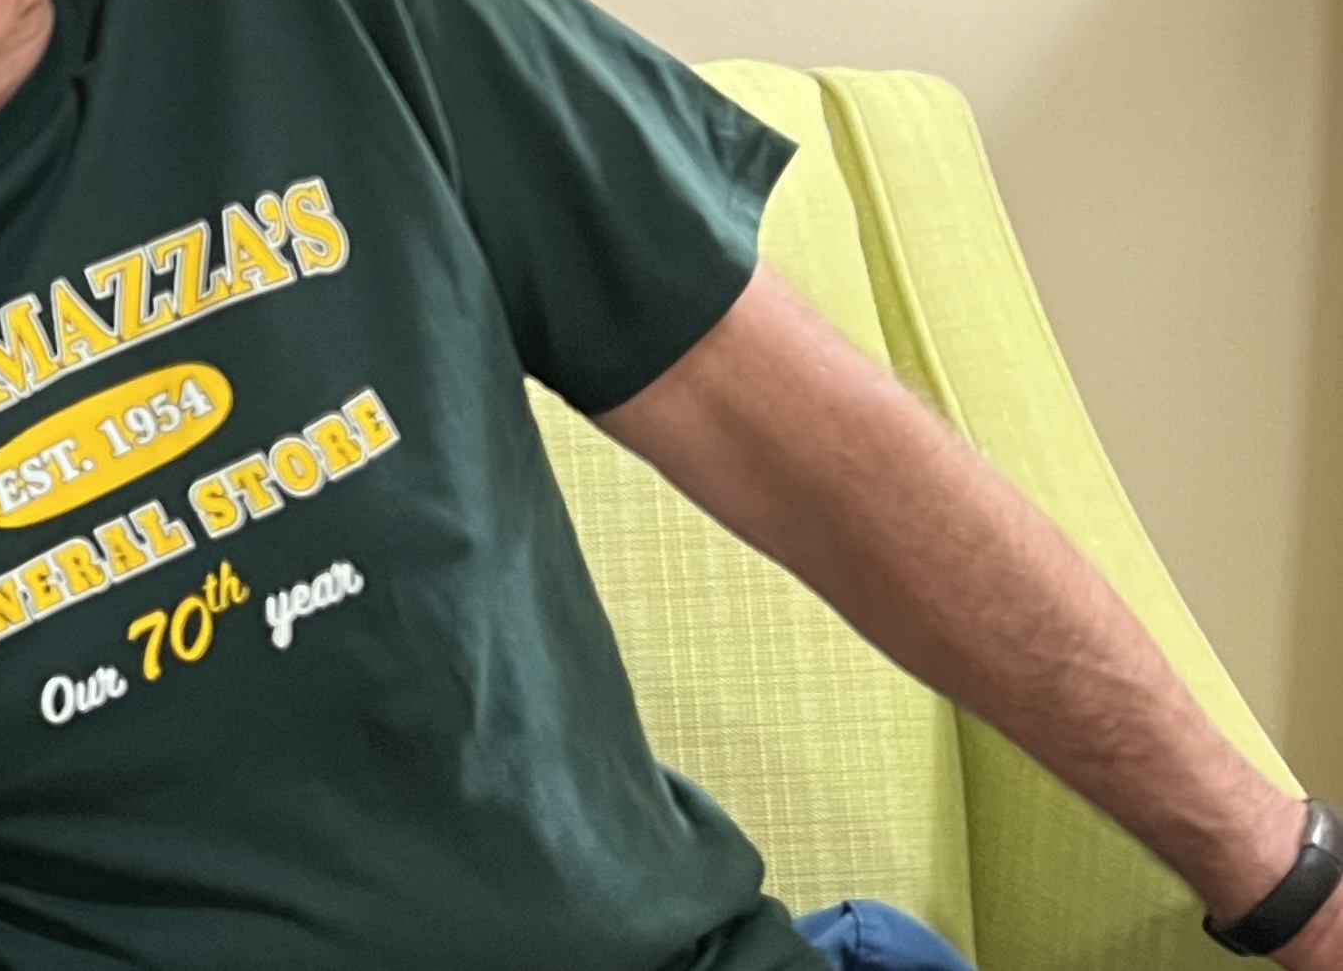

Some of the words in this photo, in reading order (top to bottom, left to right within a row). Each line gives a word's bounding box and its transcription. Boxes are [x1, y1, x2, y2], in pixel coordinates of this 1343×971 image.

[99, 379, 213, 457] 1954
[189, 388, 401, 538] STORE
[41, 666, 128, 723] Our
[264, 561, 363, 649] year
